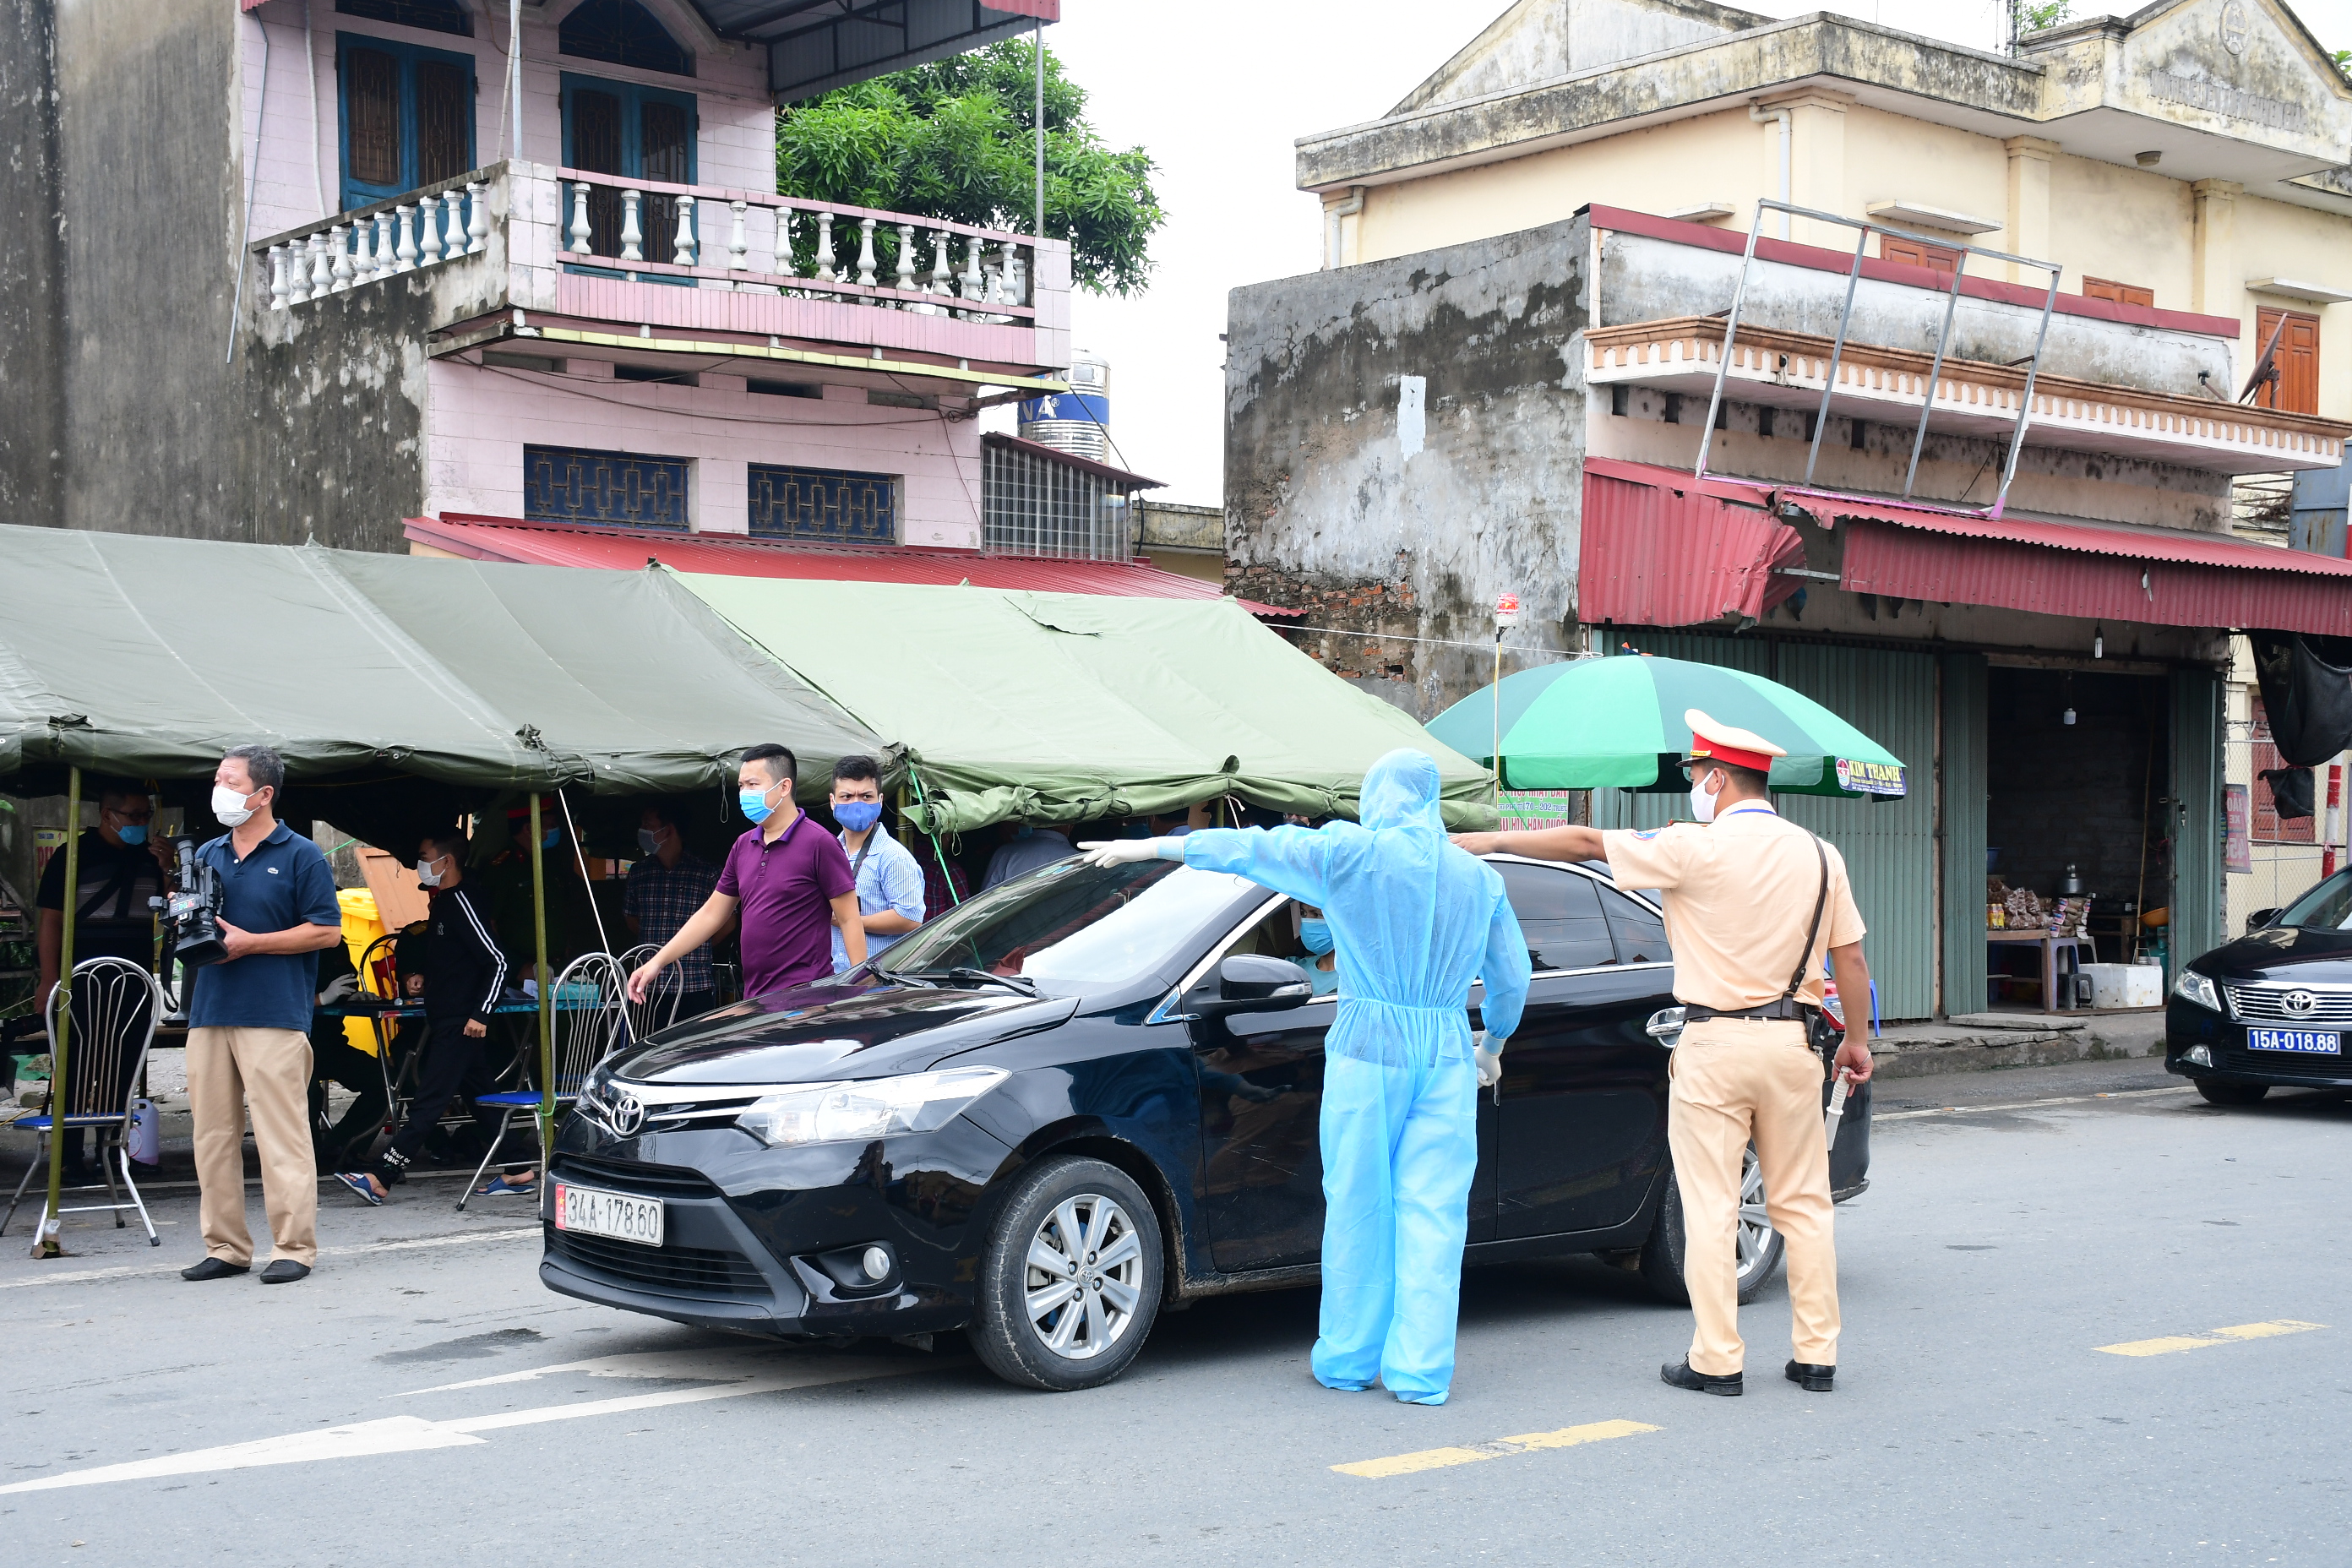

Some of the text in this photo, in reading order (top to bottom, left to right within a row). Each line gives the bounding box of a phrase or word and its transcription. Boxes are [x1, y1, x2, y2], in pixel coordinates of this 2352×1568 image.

[1848, 760, 1901, 782] KIM THANH
[1540, 803, 1552, 811] 202
[2252, 1030, 2337, 1052] 15A-018.88
[389, 1146, 405, 1160] Your
[569, 1192, 659, 1239] 34A-178.60
